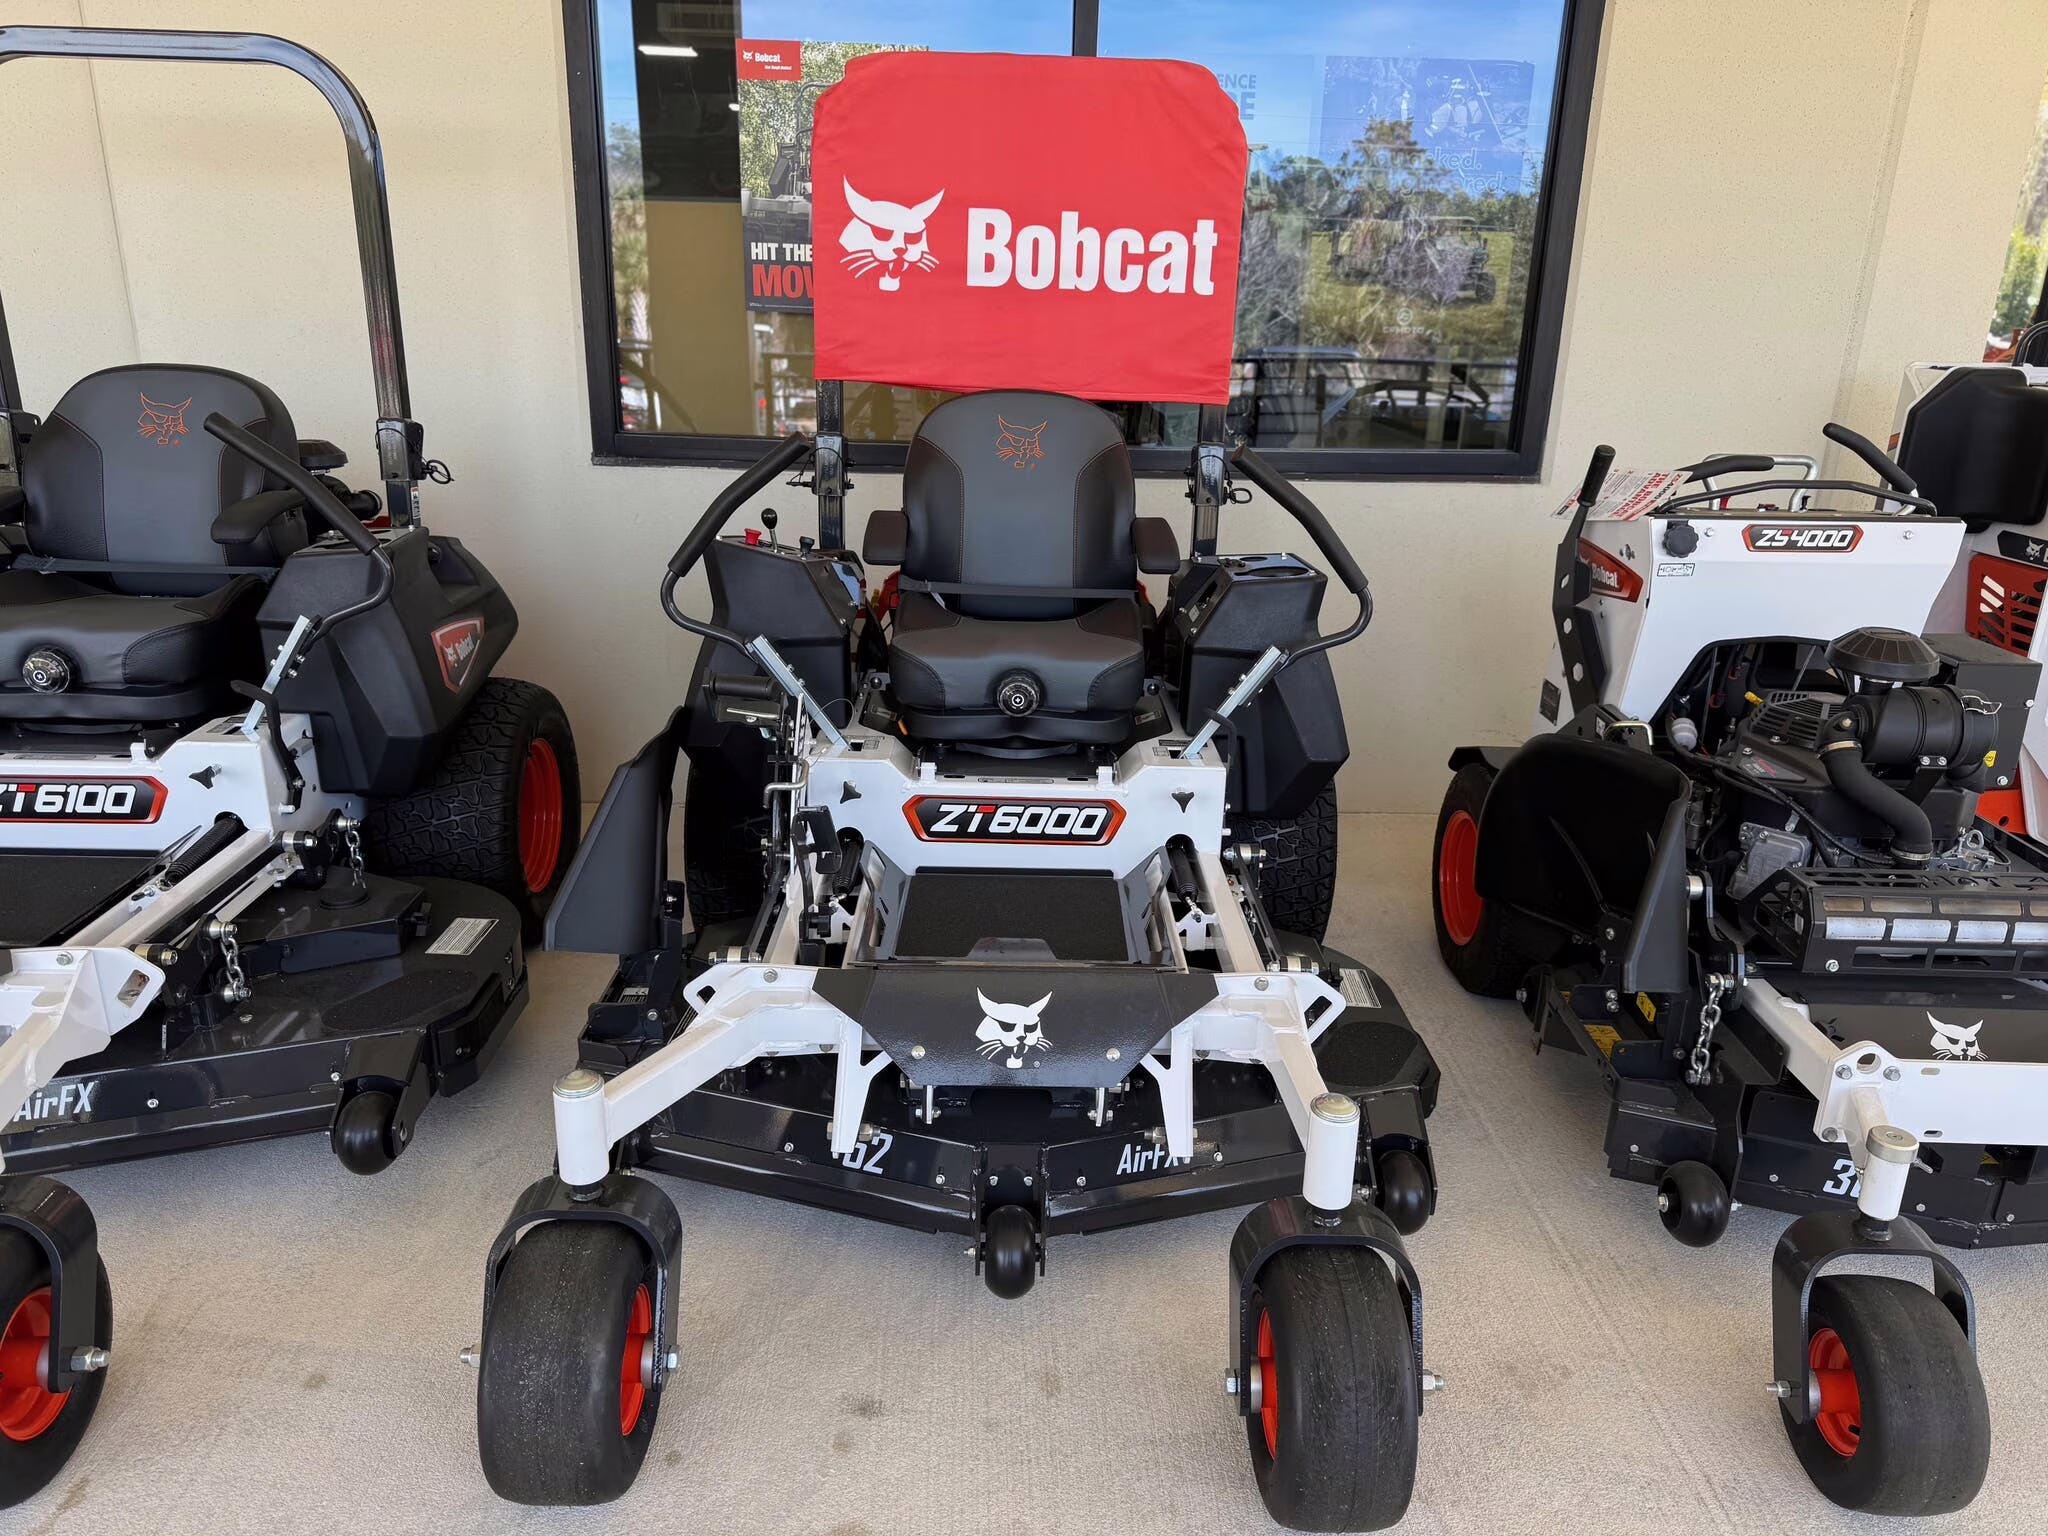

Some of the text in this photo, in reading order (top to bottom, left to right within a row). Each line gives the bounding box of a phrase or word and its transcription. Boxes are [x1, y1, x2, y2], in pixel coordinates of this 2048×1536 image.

[754, 52, 782, 62] Bobcat
[751, 242, 813, 262] HIT THE
[966, 207, 1218, 296] Bobcat
[1650, 473, 1670, 489] THE
[1755, 529, 1854, 547] ZS4000
[1591, 563, 1619, 588] Bobcat
[455, 631, 475, 661] Bobcat
[930, 804, 1108, 836] ZT6000
[13, 1082, 95, 1122] AirFX
